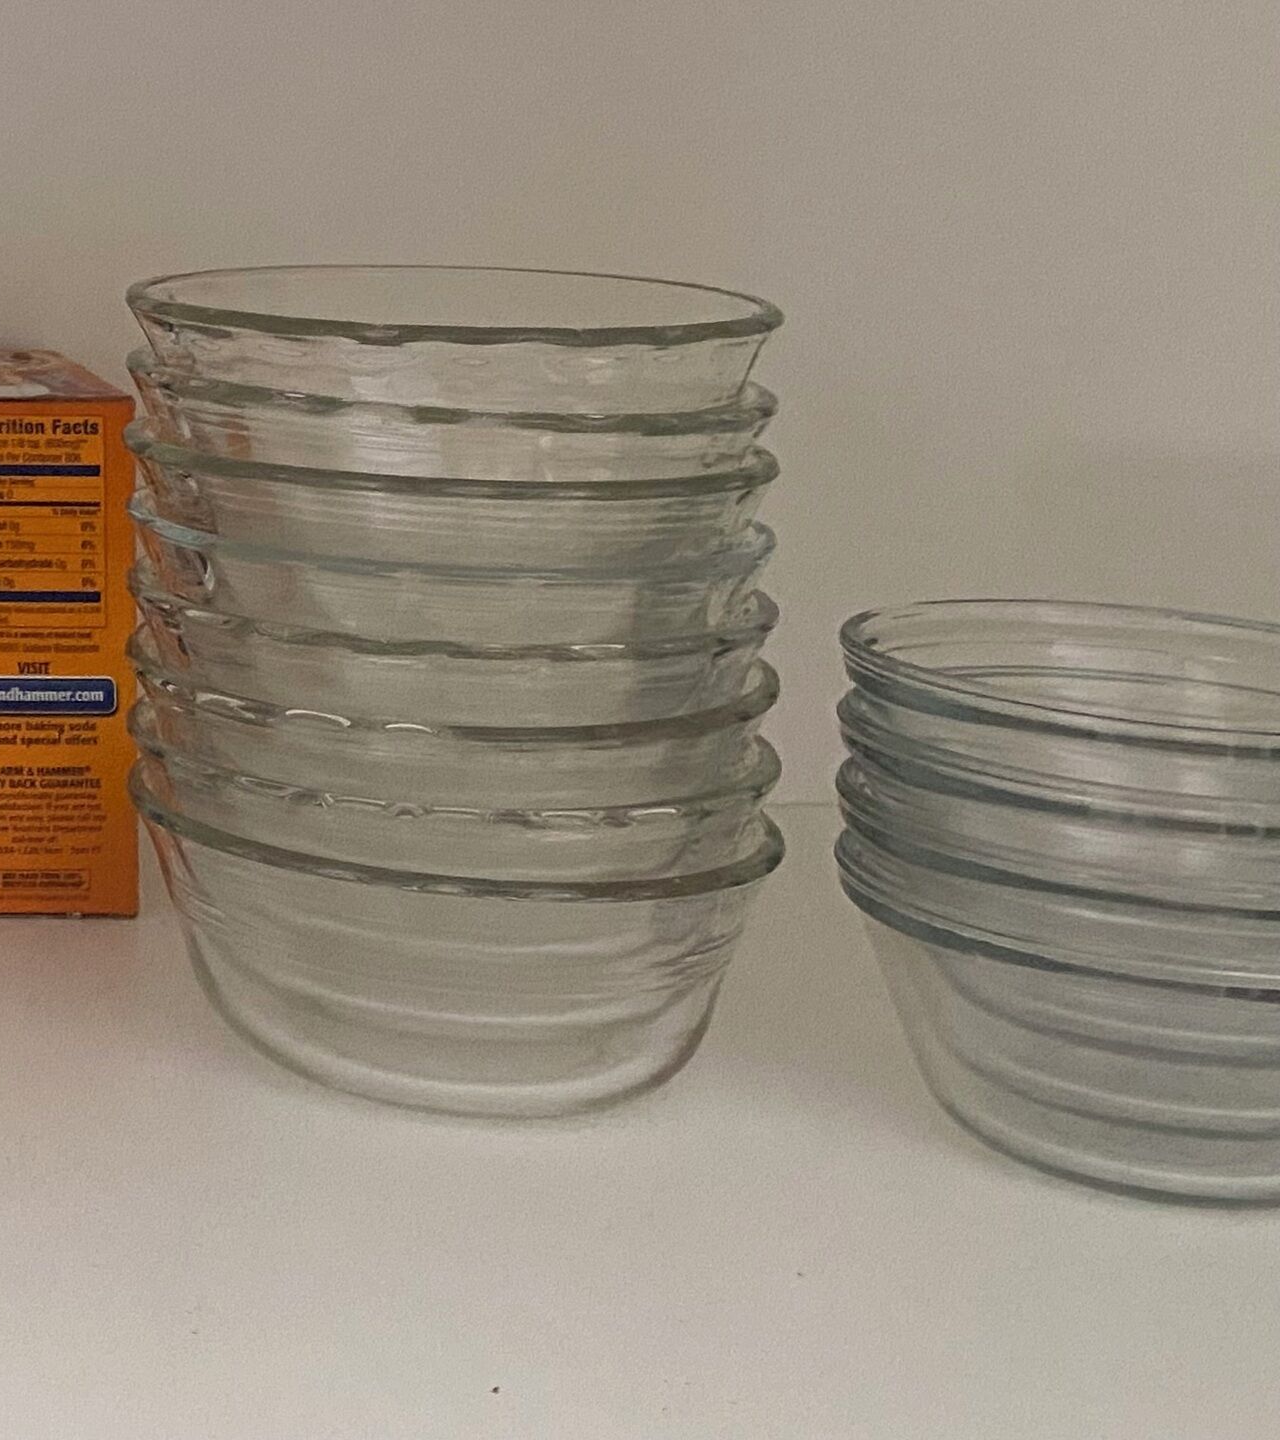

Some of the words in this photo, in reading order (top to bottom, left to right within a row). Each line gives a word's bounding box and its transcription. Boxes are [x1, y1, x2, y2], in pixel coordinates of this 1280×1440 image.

[52, 419, 100, 436] Facts
[18, 662, 51, 674] VISIT
[26, 720, 65, 735] baking
[69, 721, 97, 732] soda
[21, 733, 61, 748] special
[65, 734, 98, 746] offers
[0, 766, 24, 777] ARM
[9, 778, 37, 789] BACK
[40, 778, 102, 789] GUARANTEE
